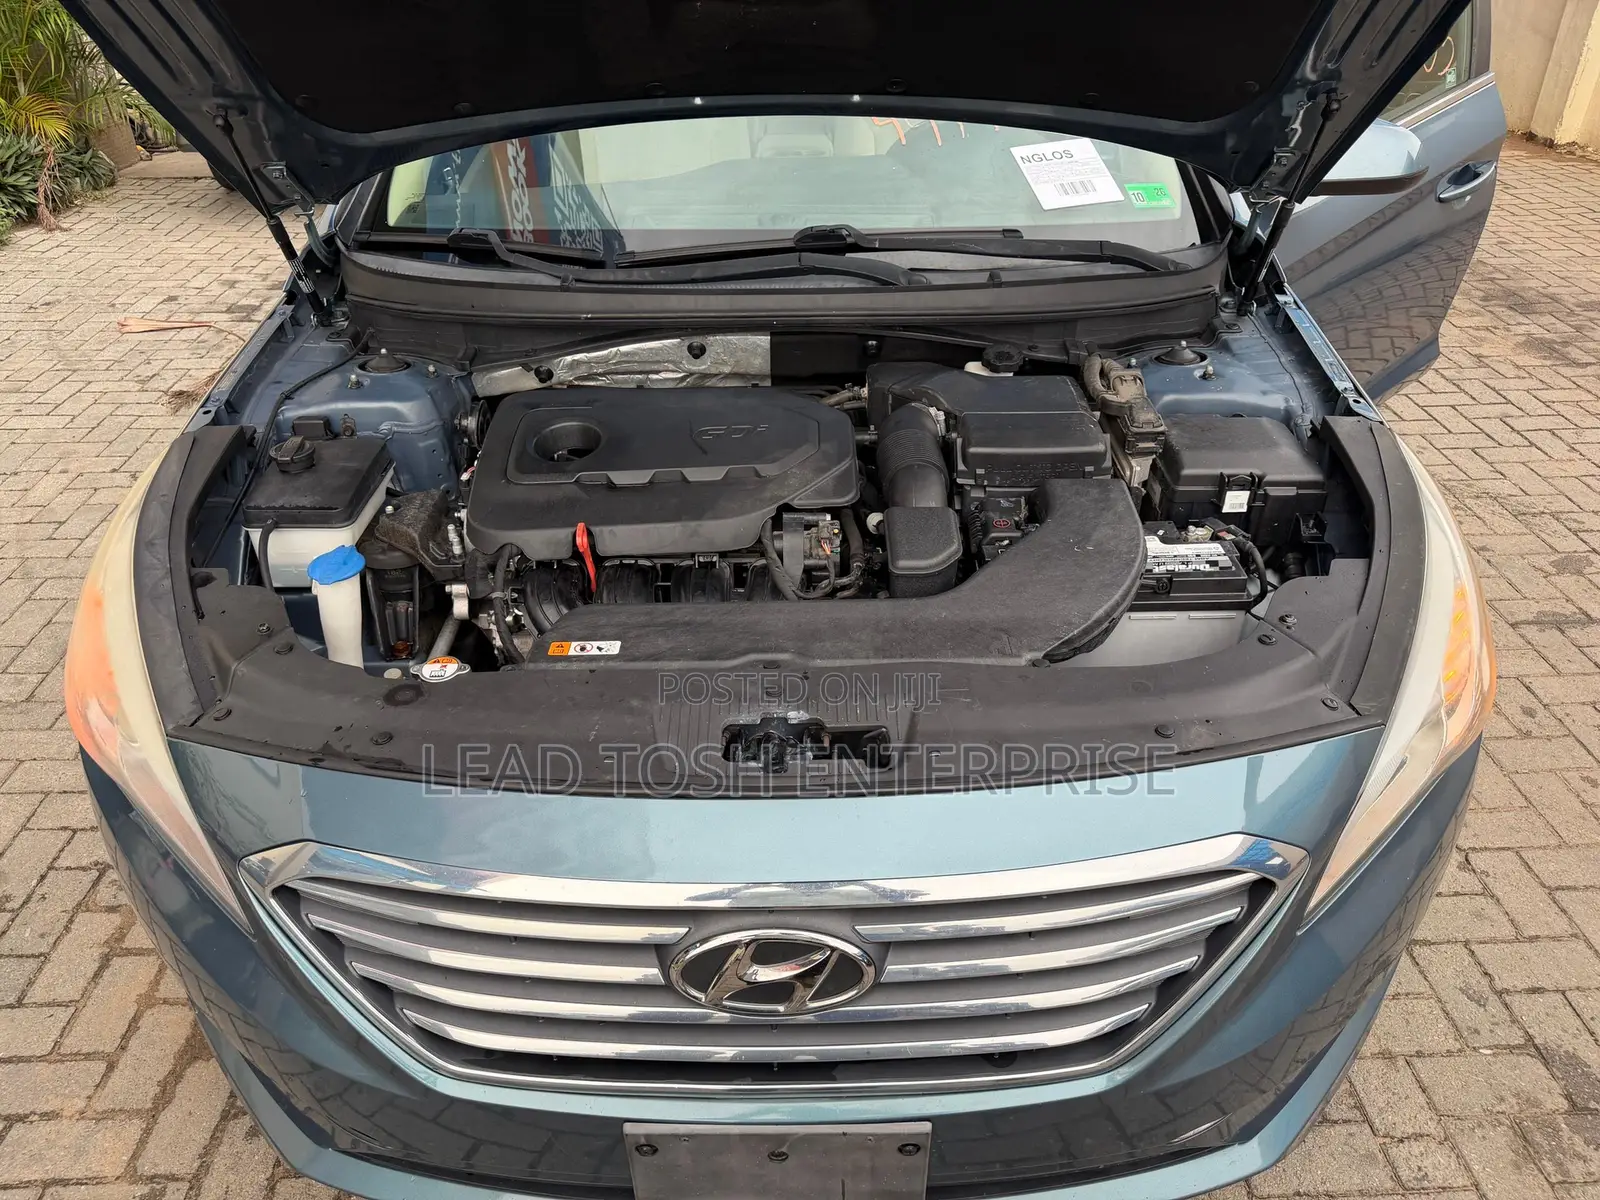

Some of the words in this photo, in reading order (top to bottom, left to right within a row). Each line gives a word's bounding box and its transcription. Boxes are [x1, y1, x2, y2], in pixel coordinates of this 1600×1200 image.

[1020, 149, 1074, 164] NGLOS
[1131, 192, 1145, 203] 10
[1153, 563, 1211, 572] Duralast
